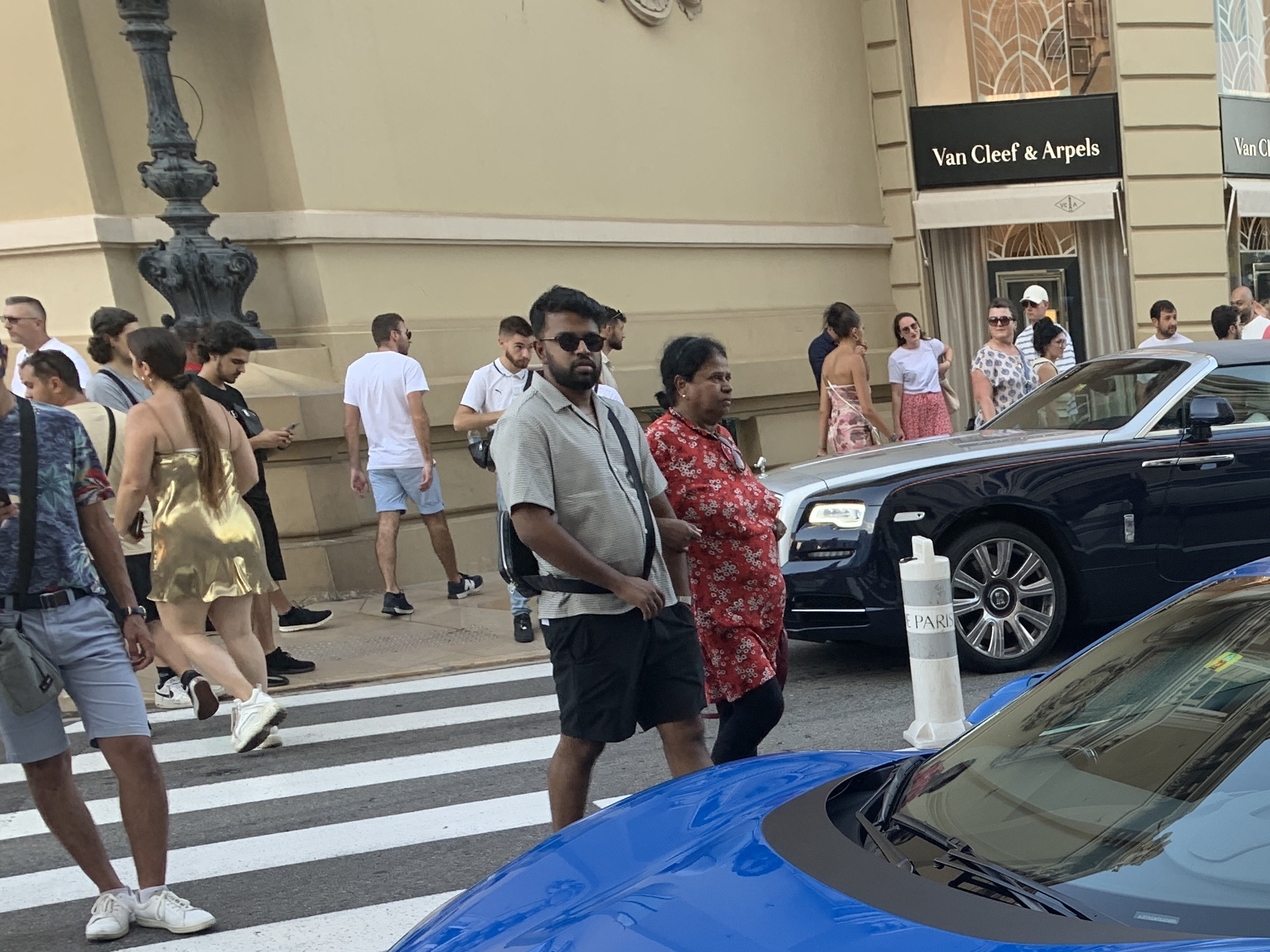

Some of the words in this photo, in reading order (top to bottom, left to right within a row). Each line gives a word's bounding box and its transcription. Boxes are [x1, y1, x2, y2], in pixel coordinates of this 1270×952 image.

[932, 148, 967, 166] Van
[971, 142, 1020, 164] Cleef
[1024, 145, 1038, 160] &
[1042, 137, 1100, 164] Arpels
[1234, 137, 1256, 156] Van
[914, 613, 953, 629] PARIS
